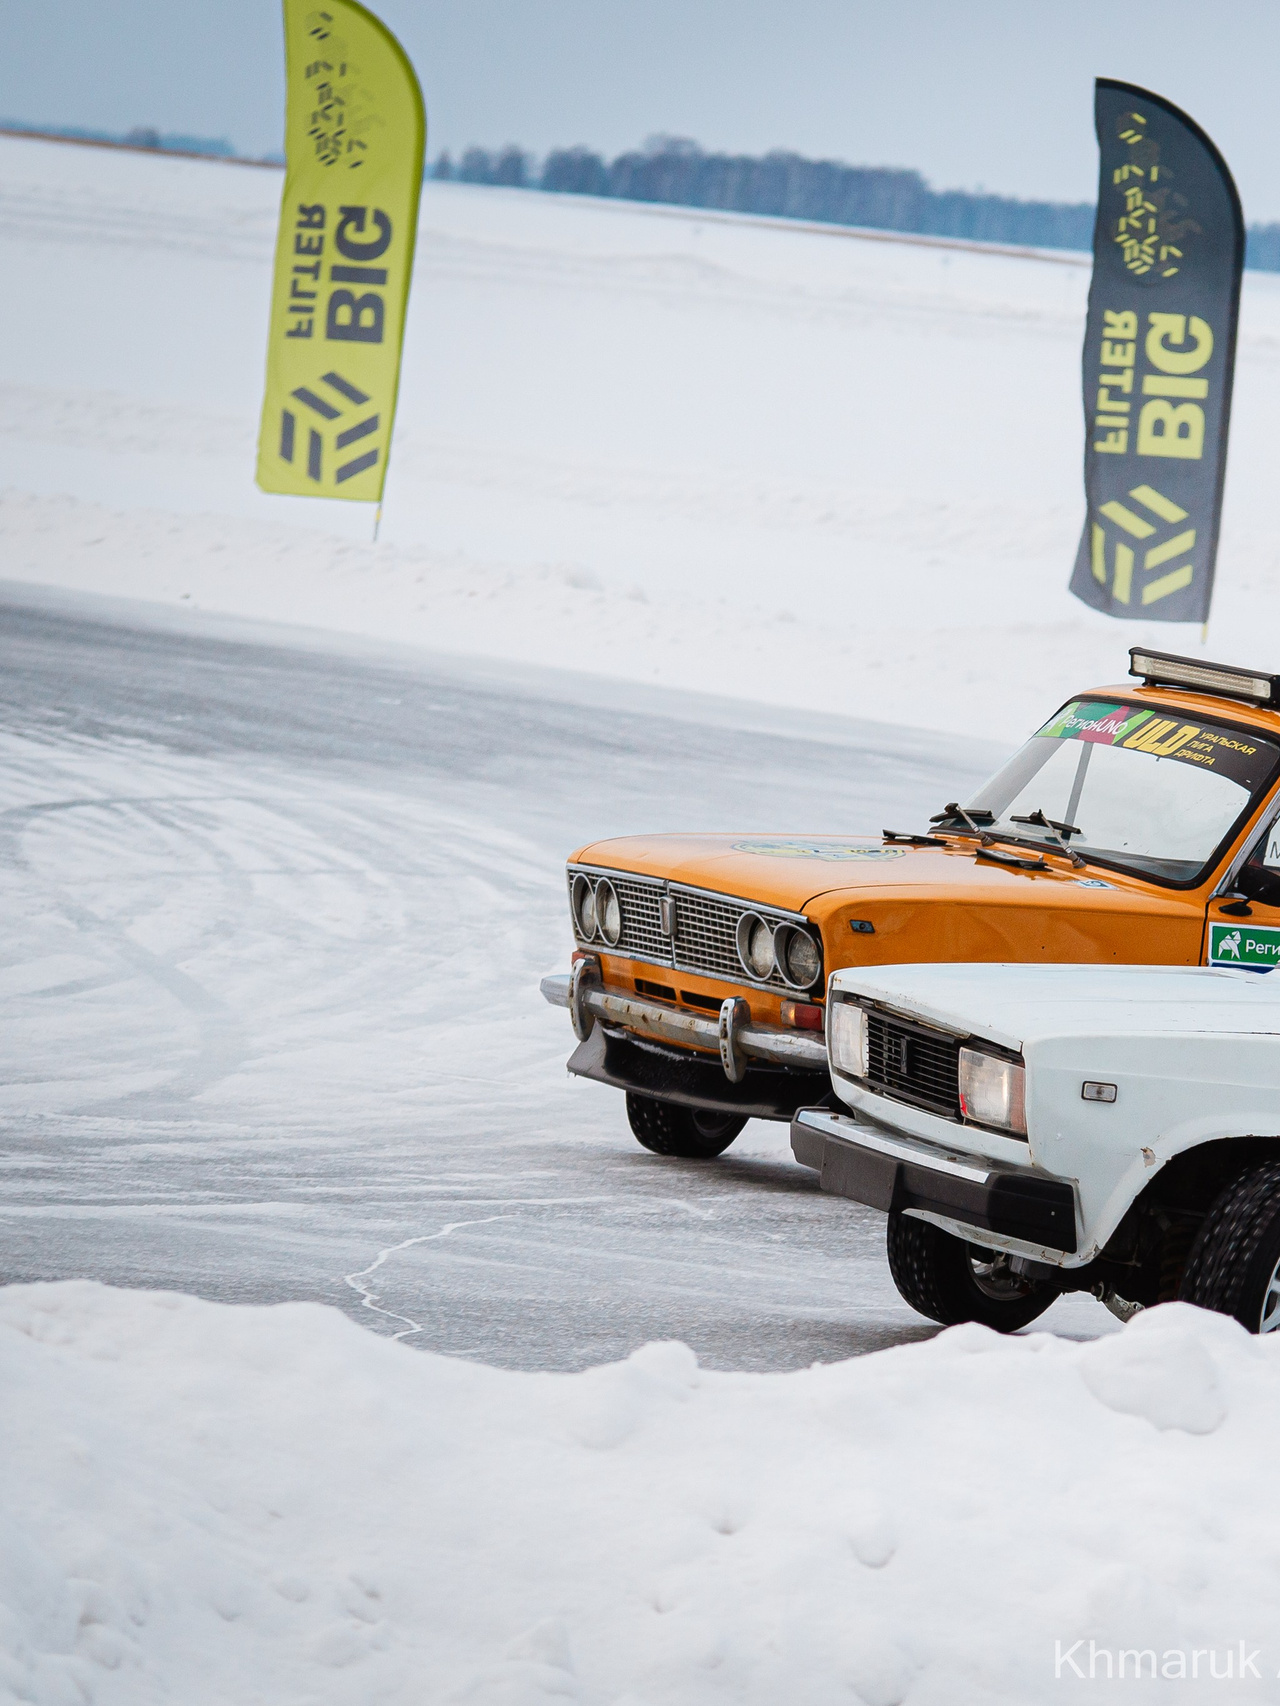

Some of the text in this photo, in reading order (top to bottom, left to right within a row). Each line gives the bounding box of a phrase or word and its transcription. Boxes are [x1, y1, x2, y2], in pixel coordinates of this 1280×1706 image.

[1187, 740, 1214, 753] ЛИГА
[1199, 731, 1257, 756] УРАЛЬСКАЯ
[1173, 749, 1216, 766] ДРИФТА
